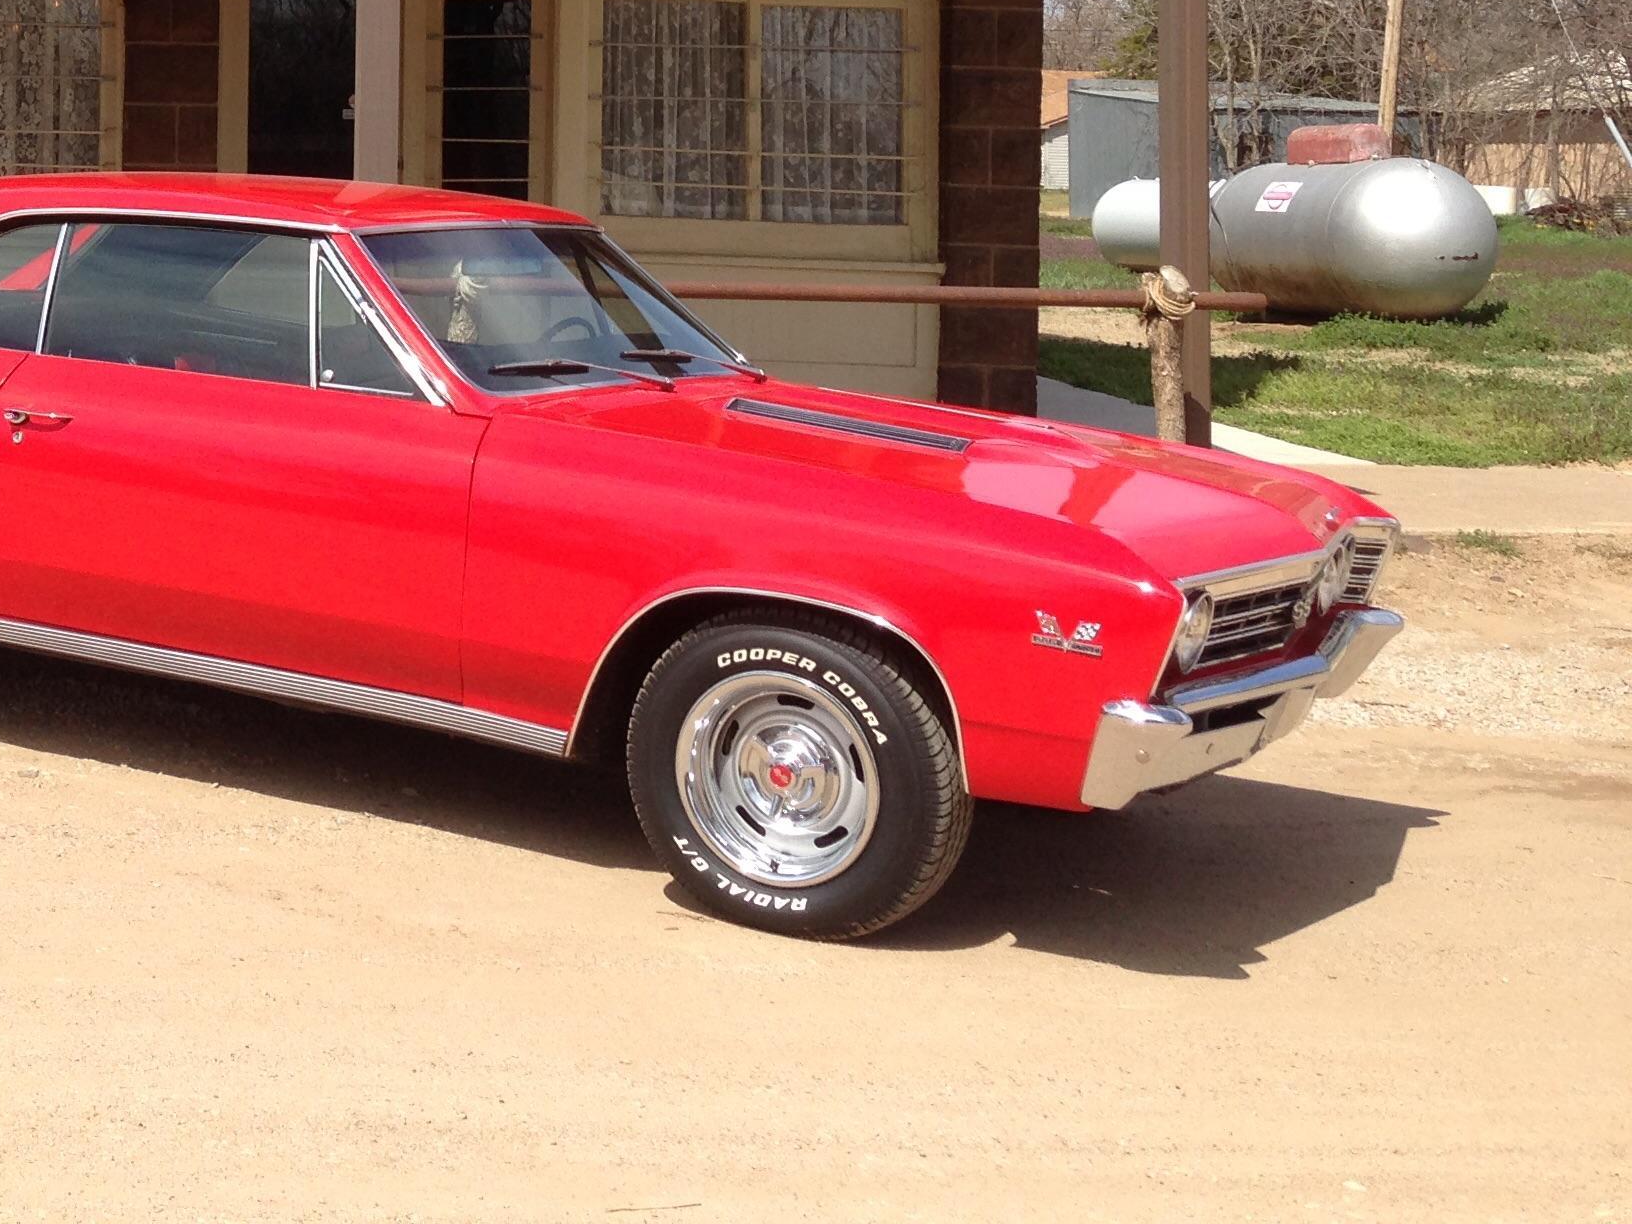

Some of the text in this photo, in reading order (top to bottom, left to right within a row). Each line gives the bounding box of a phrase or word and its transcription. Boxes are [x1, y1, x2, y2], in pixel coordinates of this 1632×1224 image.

[717, 647, 888, 745] COOPER COBRA
[672, 835, 808, 911] RADIAL G/T
